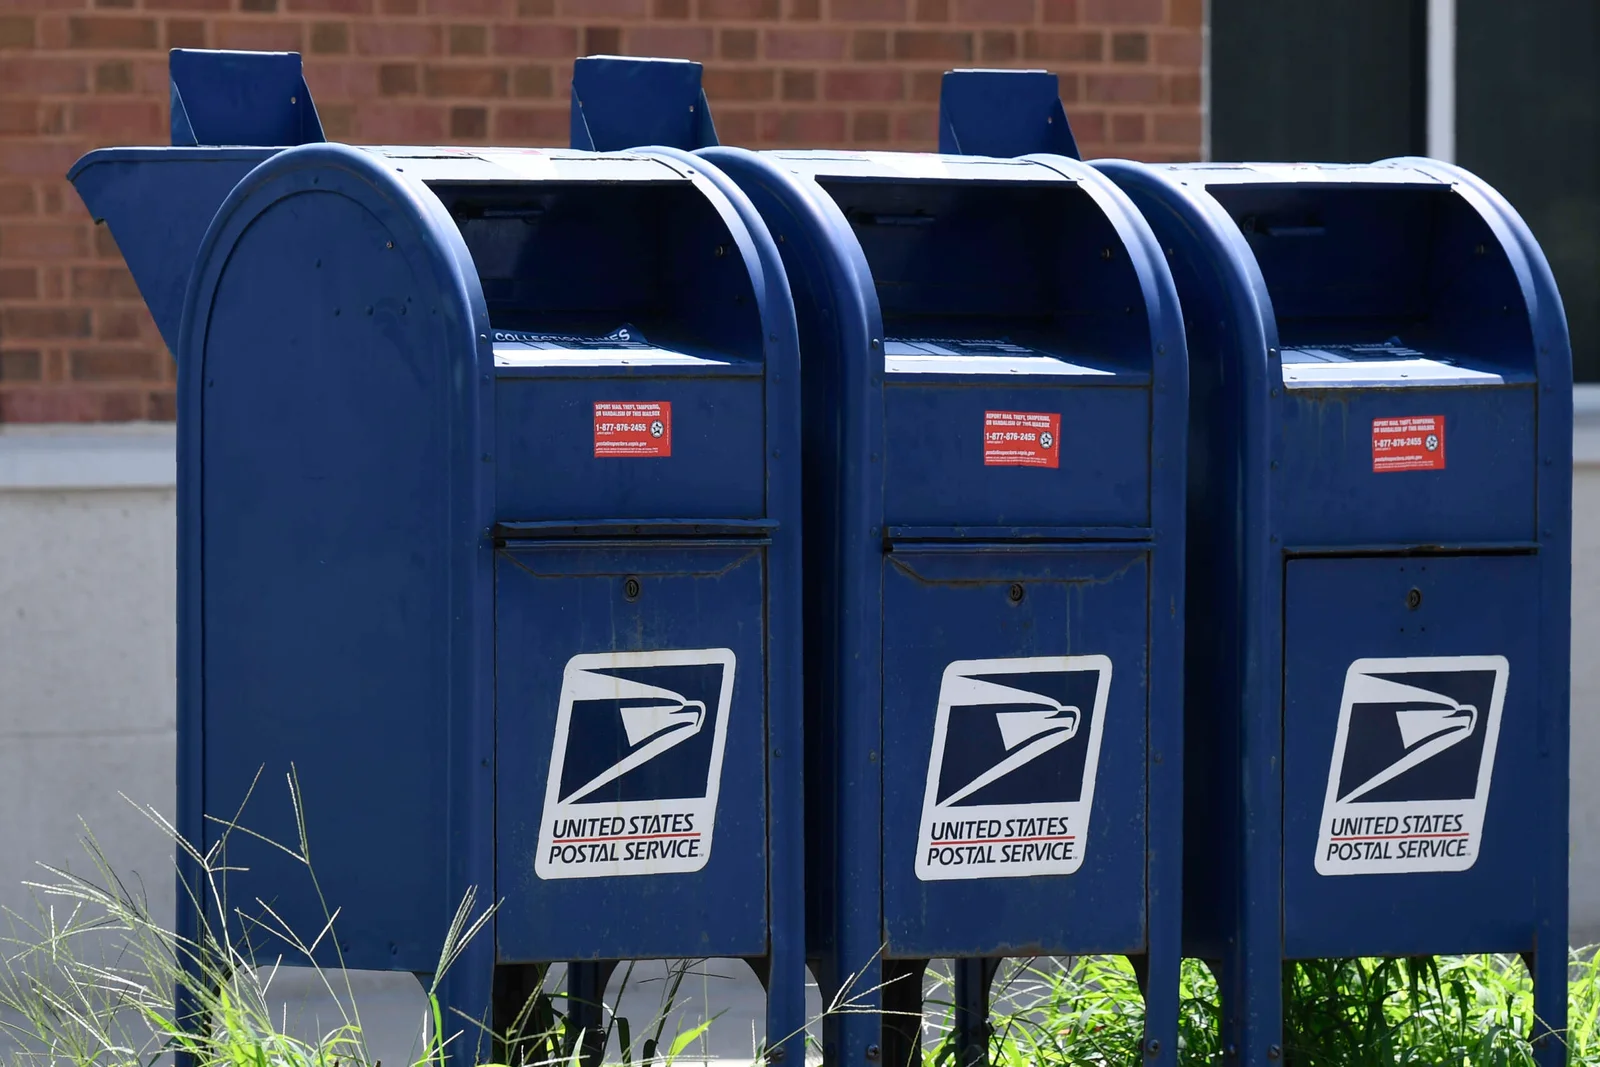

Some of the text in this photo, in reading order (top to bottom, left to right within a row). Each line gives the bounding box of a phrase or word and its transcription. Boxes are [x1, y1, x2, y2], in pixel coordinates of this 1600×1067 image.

[596, 423, 646, 432] 1-877-876-2455
[553, 813, 694, 838] UNITED STATES
[930, 816, 1069, 840] UNITED STATES
[1330, 813, 1464, 836] UNITED STATES
[549, 839, 701, 864] POSTAL SERVICE
[927, 841, 1074, 866] POSTAL SERVICE
[1326, 838, 1469, 861] POSTAL SERVICE
